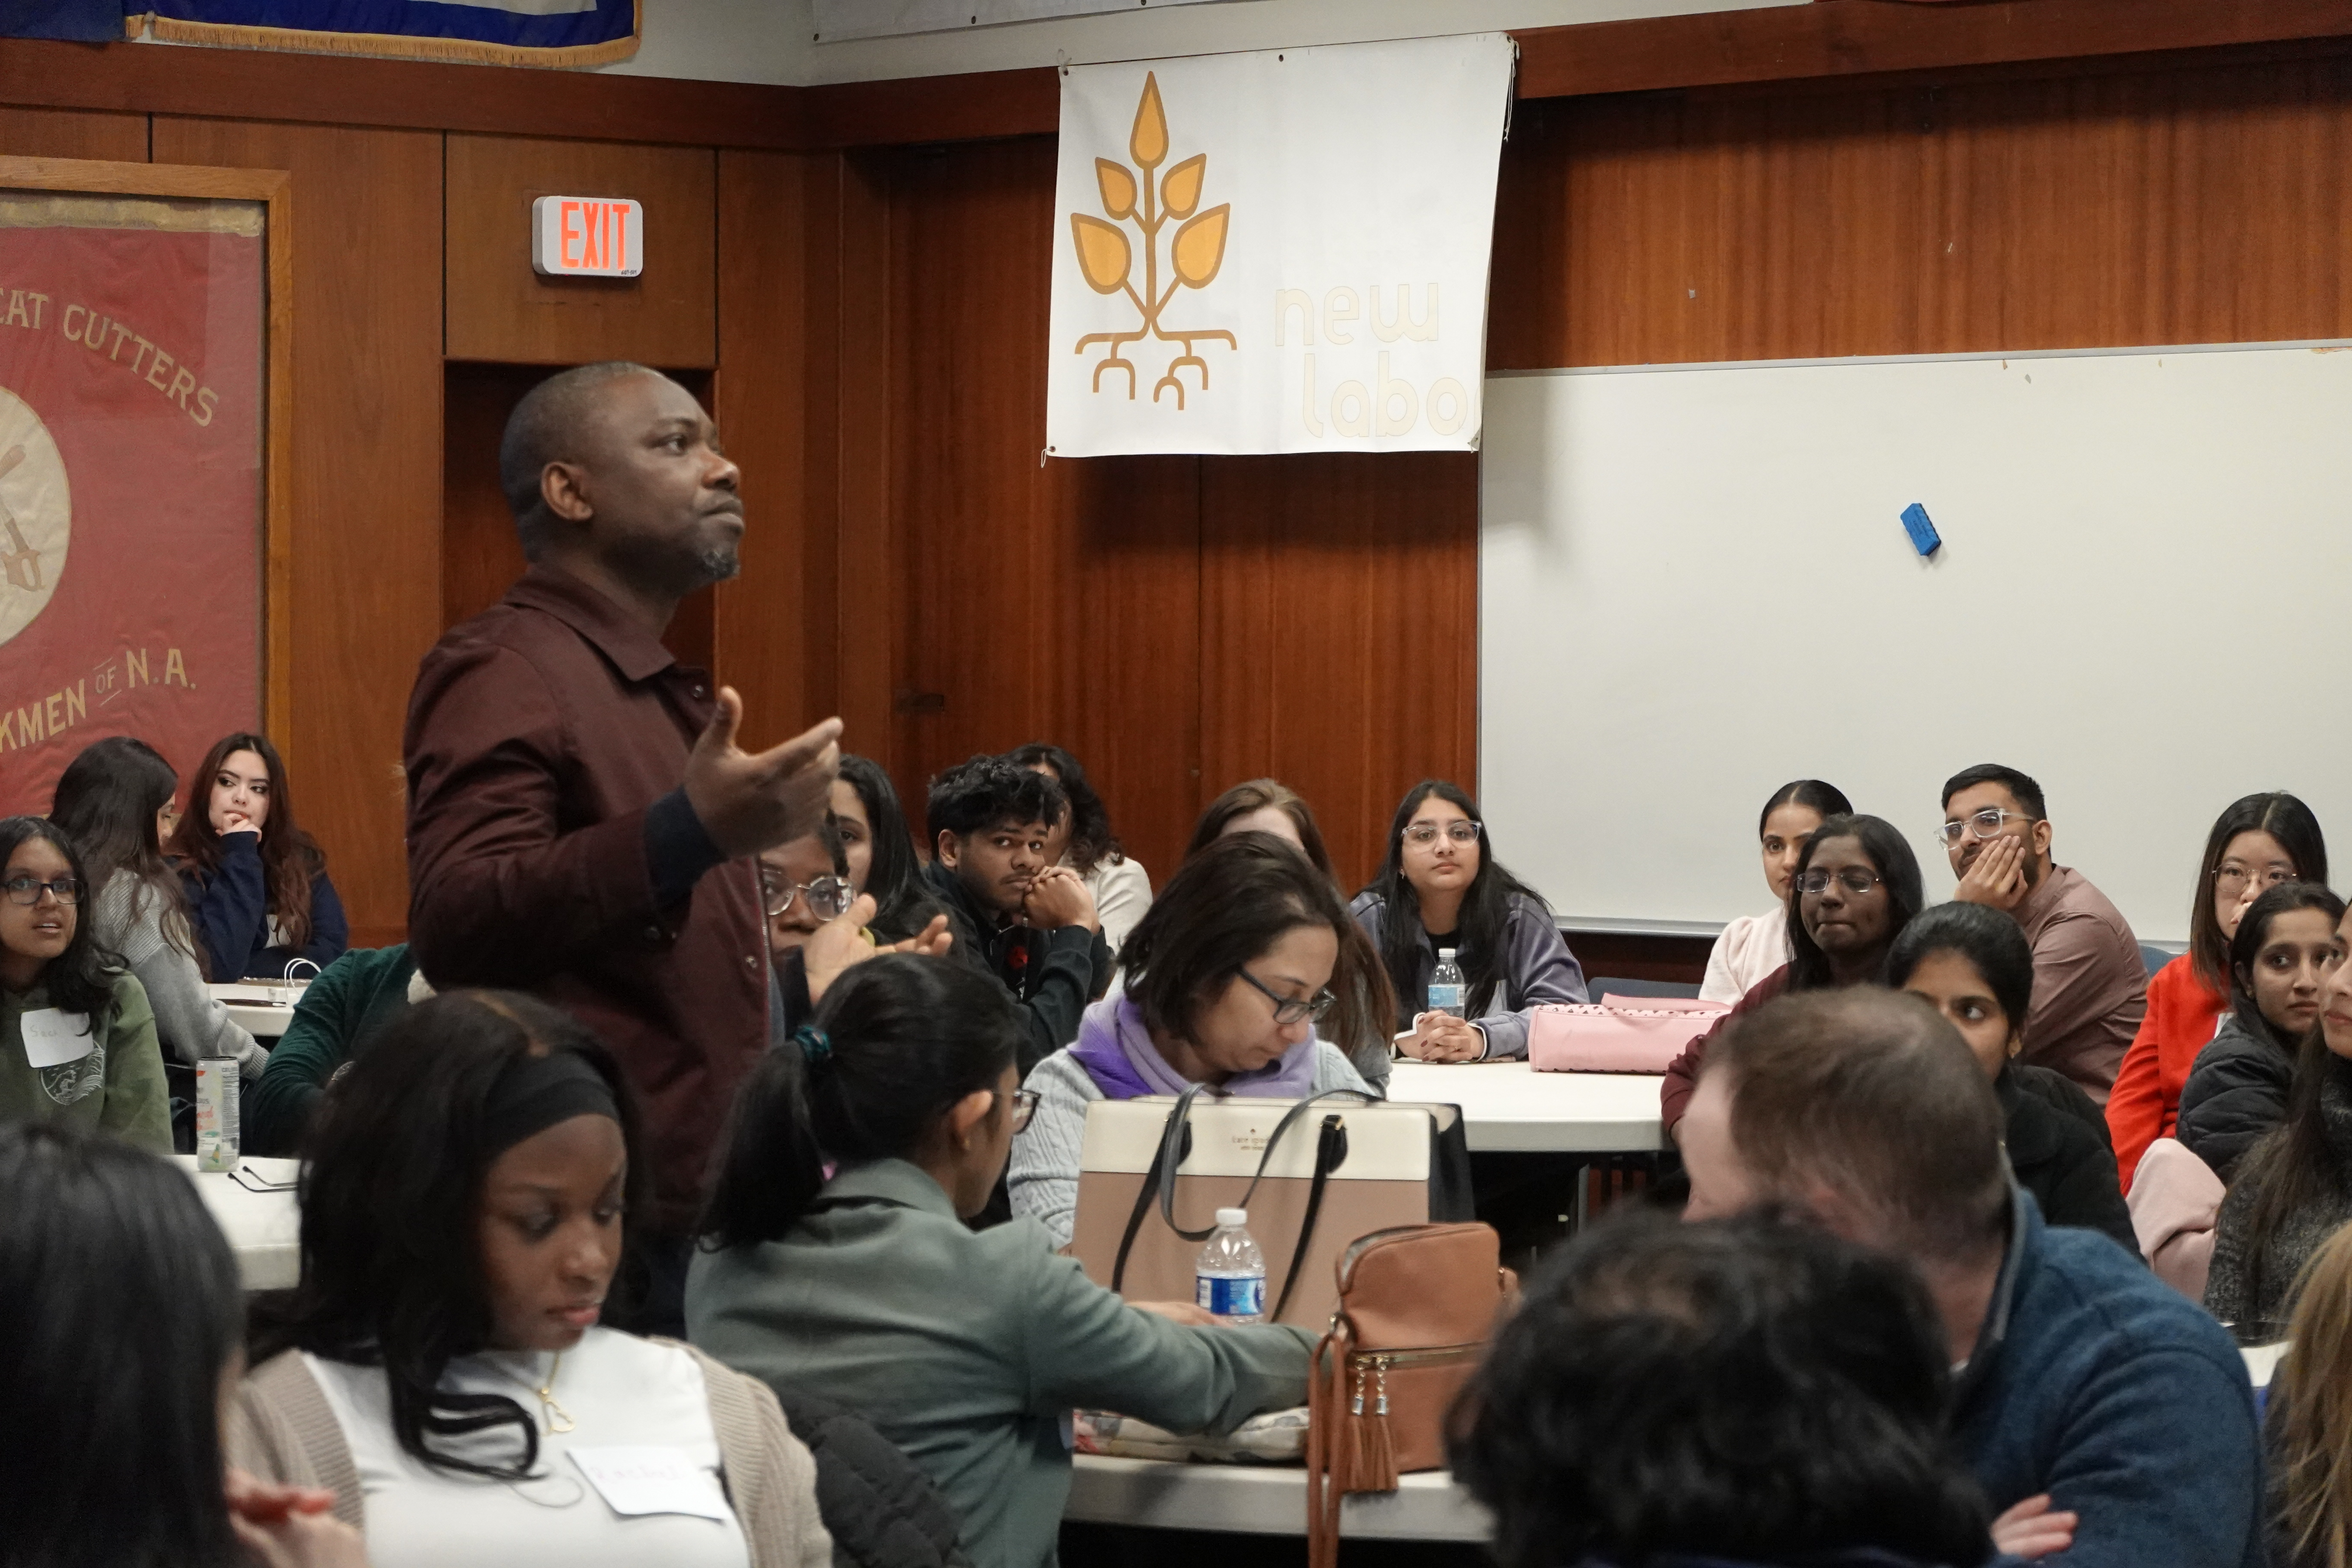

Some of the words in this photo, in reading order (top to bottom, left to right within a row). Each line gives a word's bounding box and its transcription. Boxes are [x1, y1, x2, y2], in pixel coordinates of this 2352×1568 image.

[561, 202, 630, 270] EXIT
[1275, 283, 1439, 346] new
[0, 288, 49, 330] AT
[63, 303, 219, 427] CUTTERS
[95, 666, 117, 694] OF
